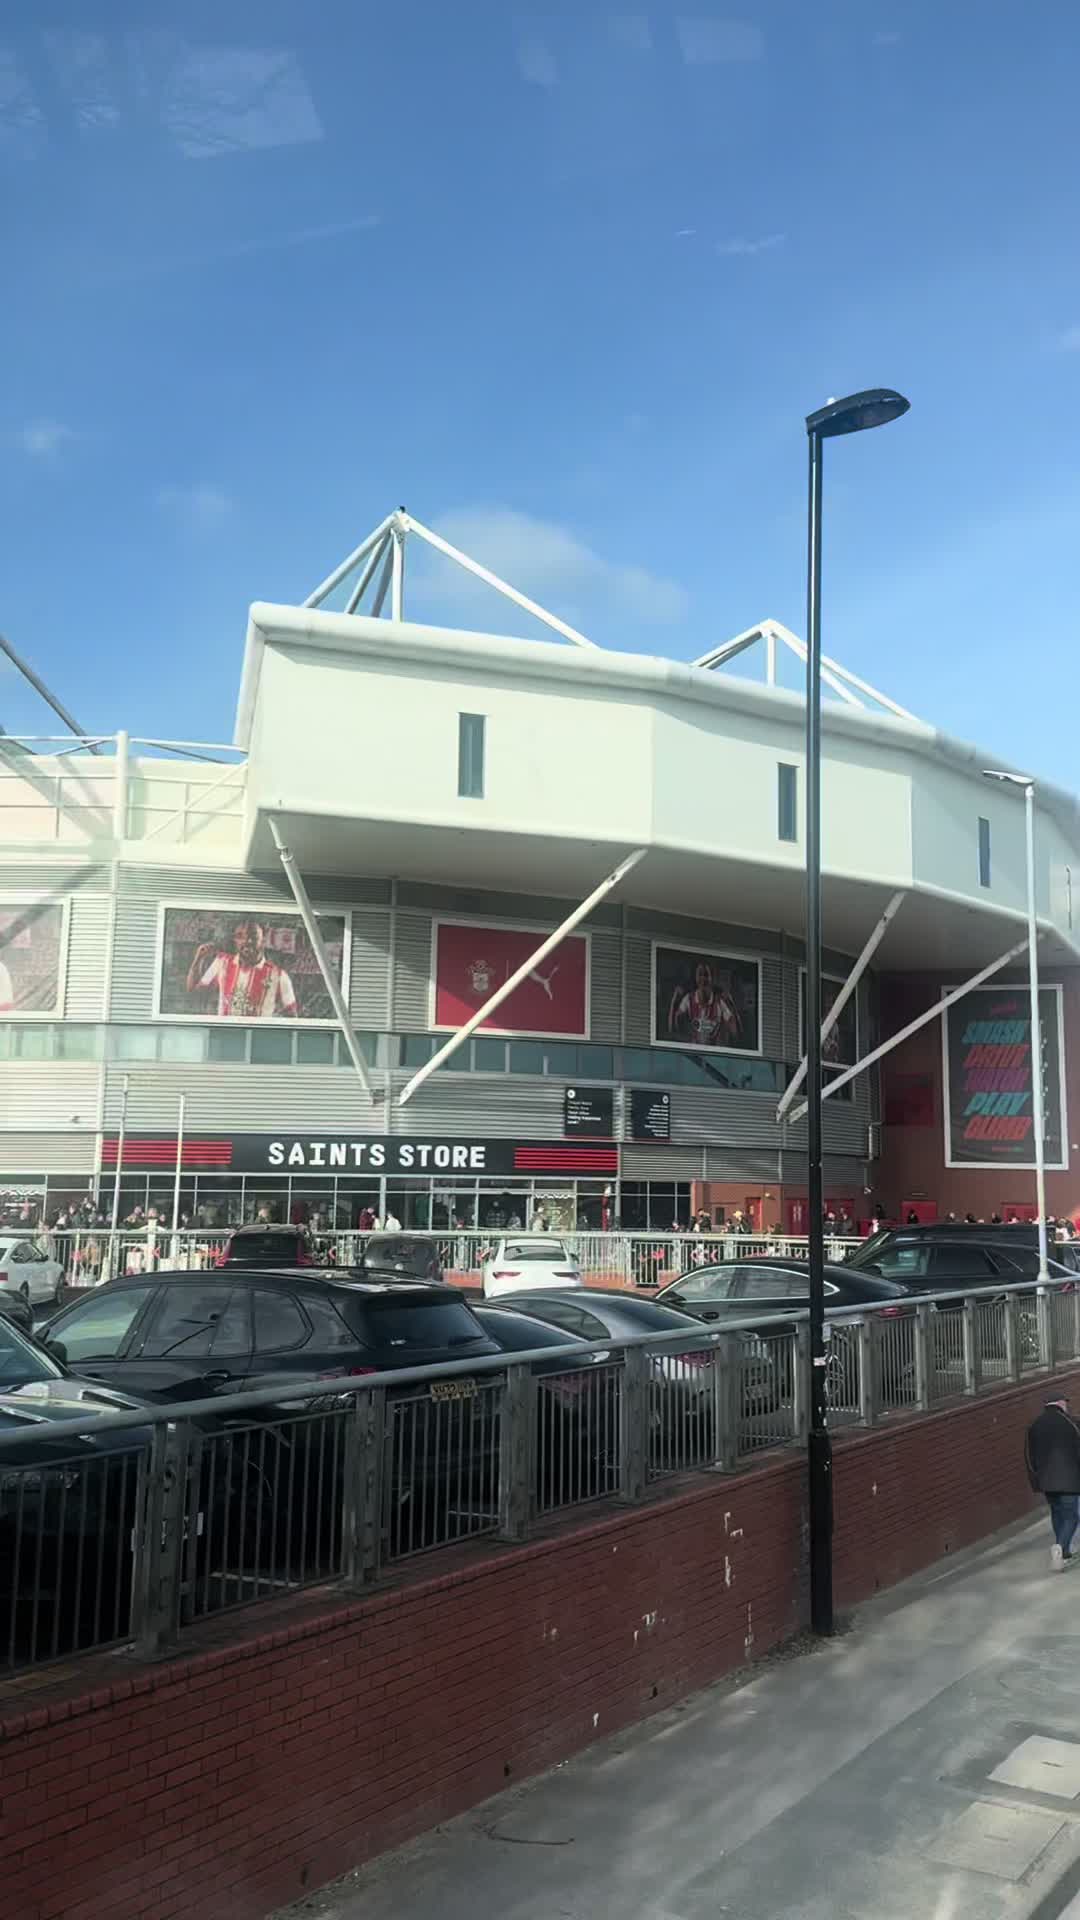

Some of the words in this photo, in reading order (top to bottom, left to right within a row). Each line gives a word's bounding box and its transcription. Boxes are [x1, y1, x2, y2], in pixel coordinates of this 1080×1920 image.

[962, 1092, 1032, 1116] PLAY
[268, 1143, 385, 1166] SAINTS
[399, 1145, 486, 1168] STORE
